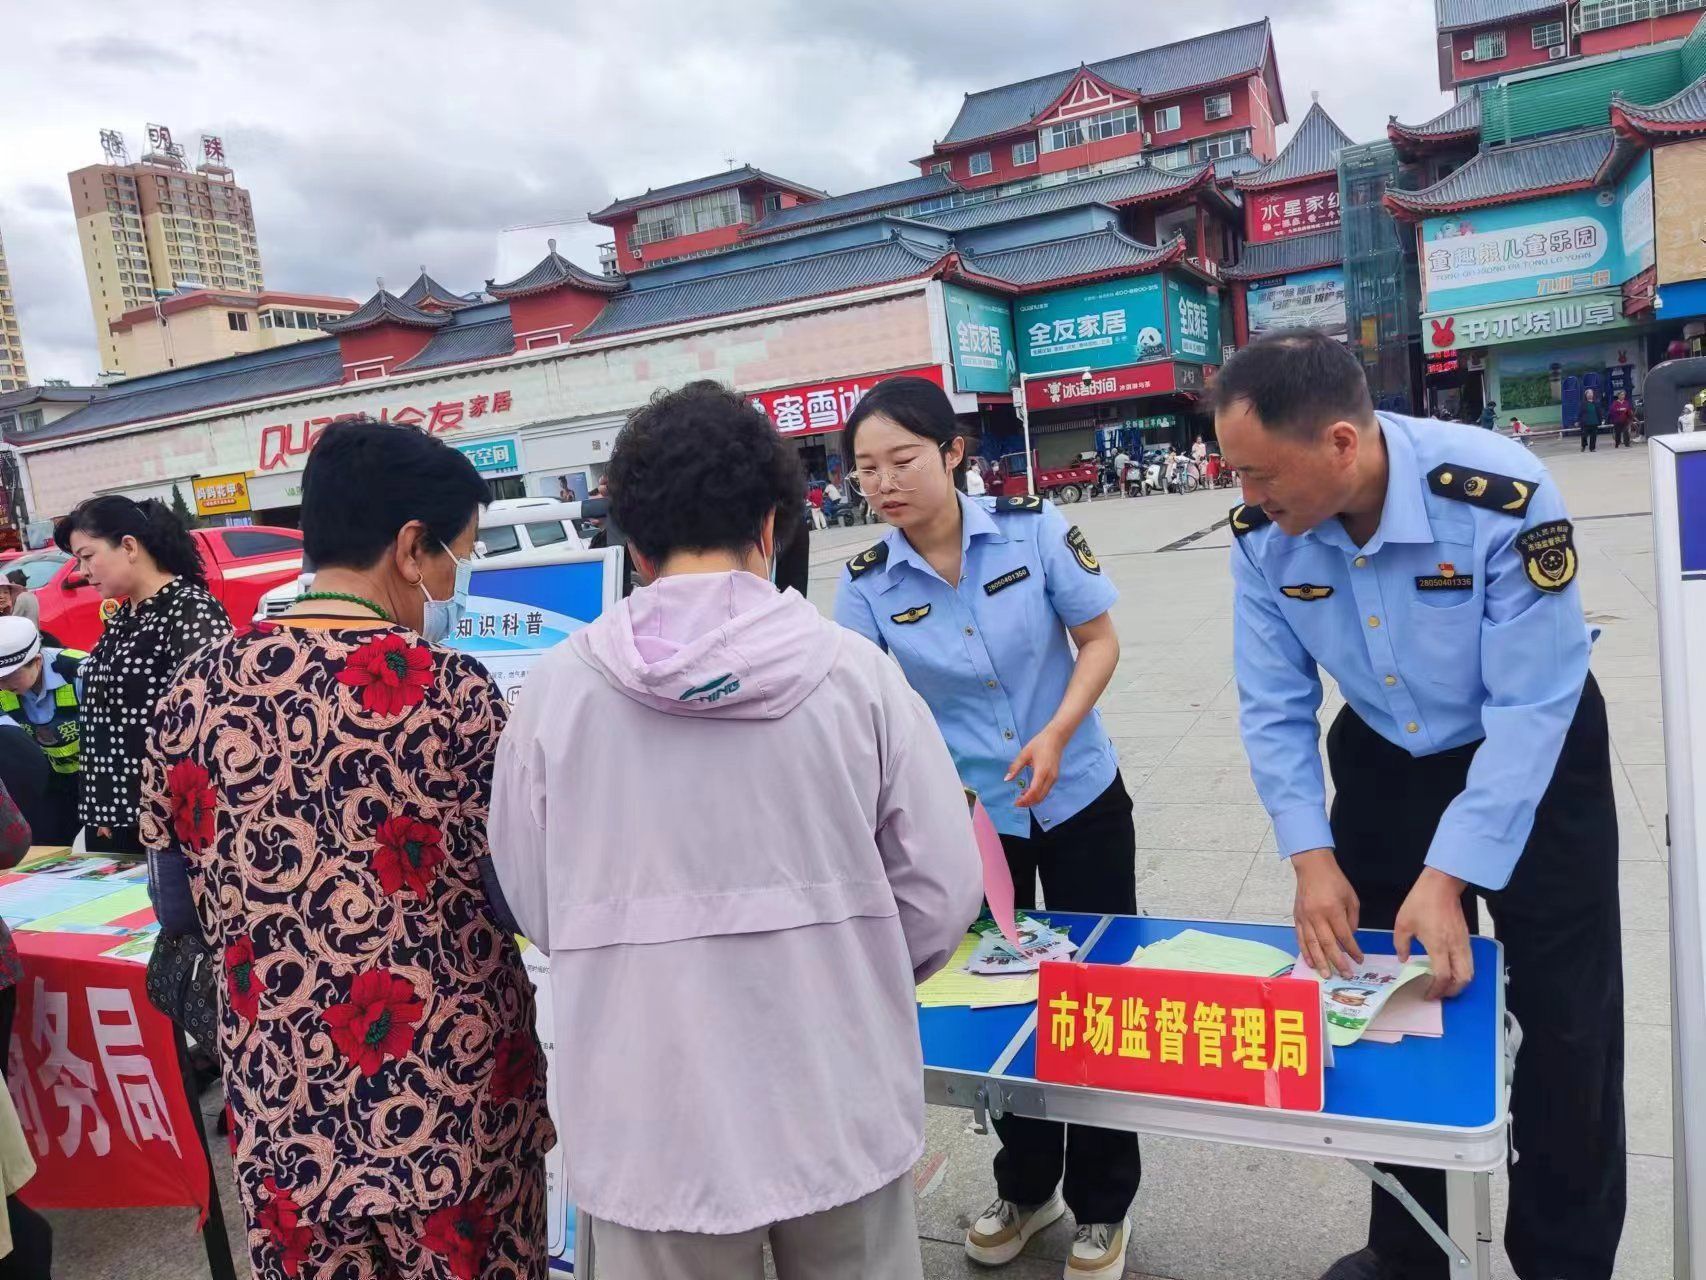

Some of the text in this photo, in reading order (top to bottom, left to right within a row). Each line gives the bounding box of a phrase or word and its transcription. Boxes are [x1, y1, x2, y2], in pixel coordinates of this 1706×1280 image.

[1429, 225, 1597, 272] 童趣熊儿童乐园
[956, 320, 1002, 356] 全友家居
[1028, 309, 1127, 346] 全友家居
[1179, 296, 1208, 340] 全友家居
[1461, 300, 1615, 343] 书亦烧仙草
[773, 383, 876, 432] 蜜雪冰
[1419, 578, 1472, 587] 28050401336
[455, 611, 543, 638] 知识科普
[1048, 990, 1309, 1076] 市场监督管理局
